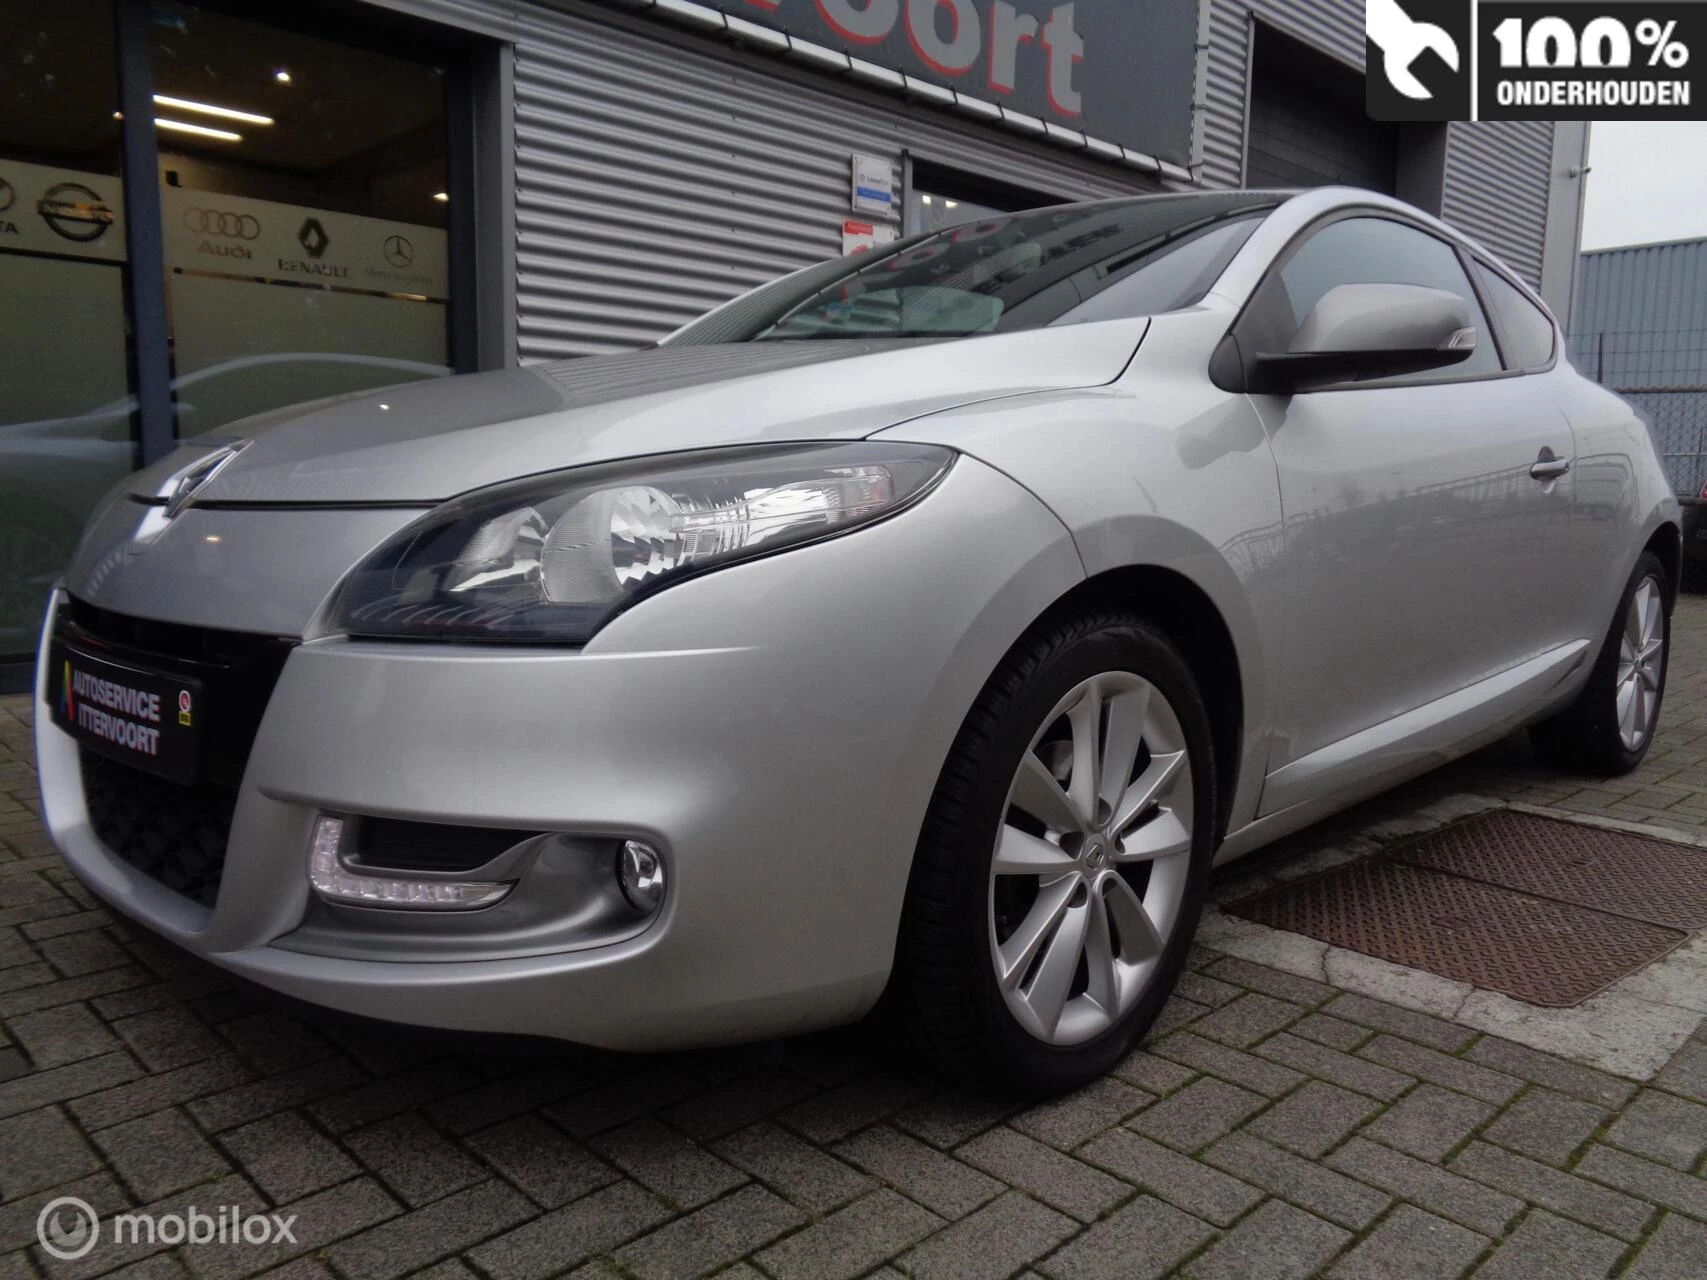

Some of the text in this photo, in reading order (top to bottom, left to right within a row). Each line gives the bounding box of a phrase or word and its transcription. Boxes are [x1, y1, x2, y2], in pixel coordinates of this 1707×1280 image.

[196, 239, 253, 260] Audi
[73, 669, 160, 722] AUTOSERVICE
[78, 702, 160, 756] ITTERVOORT
